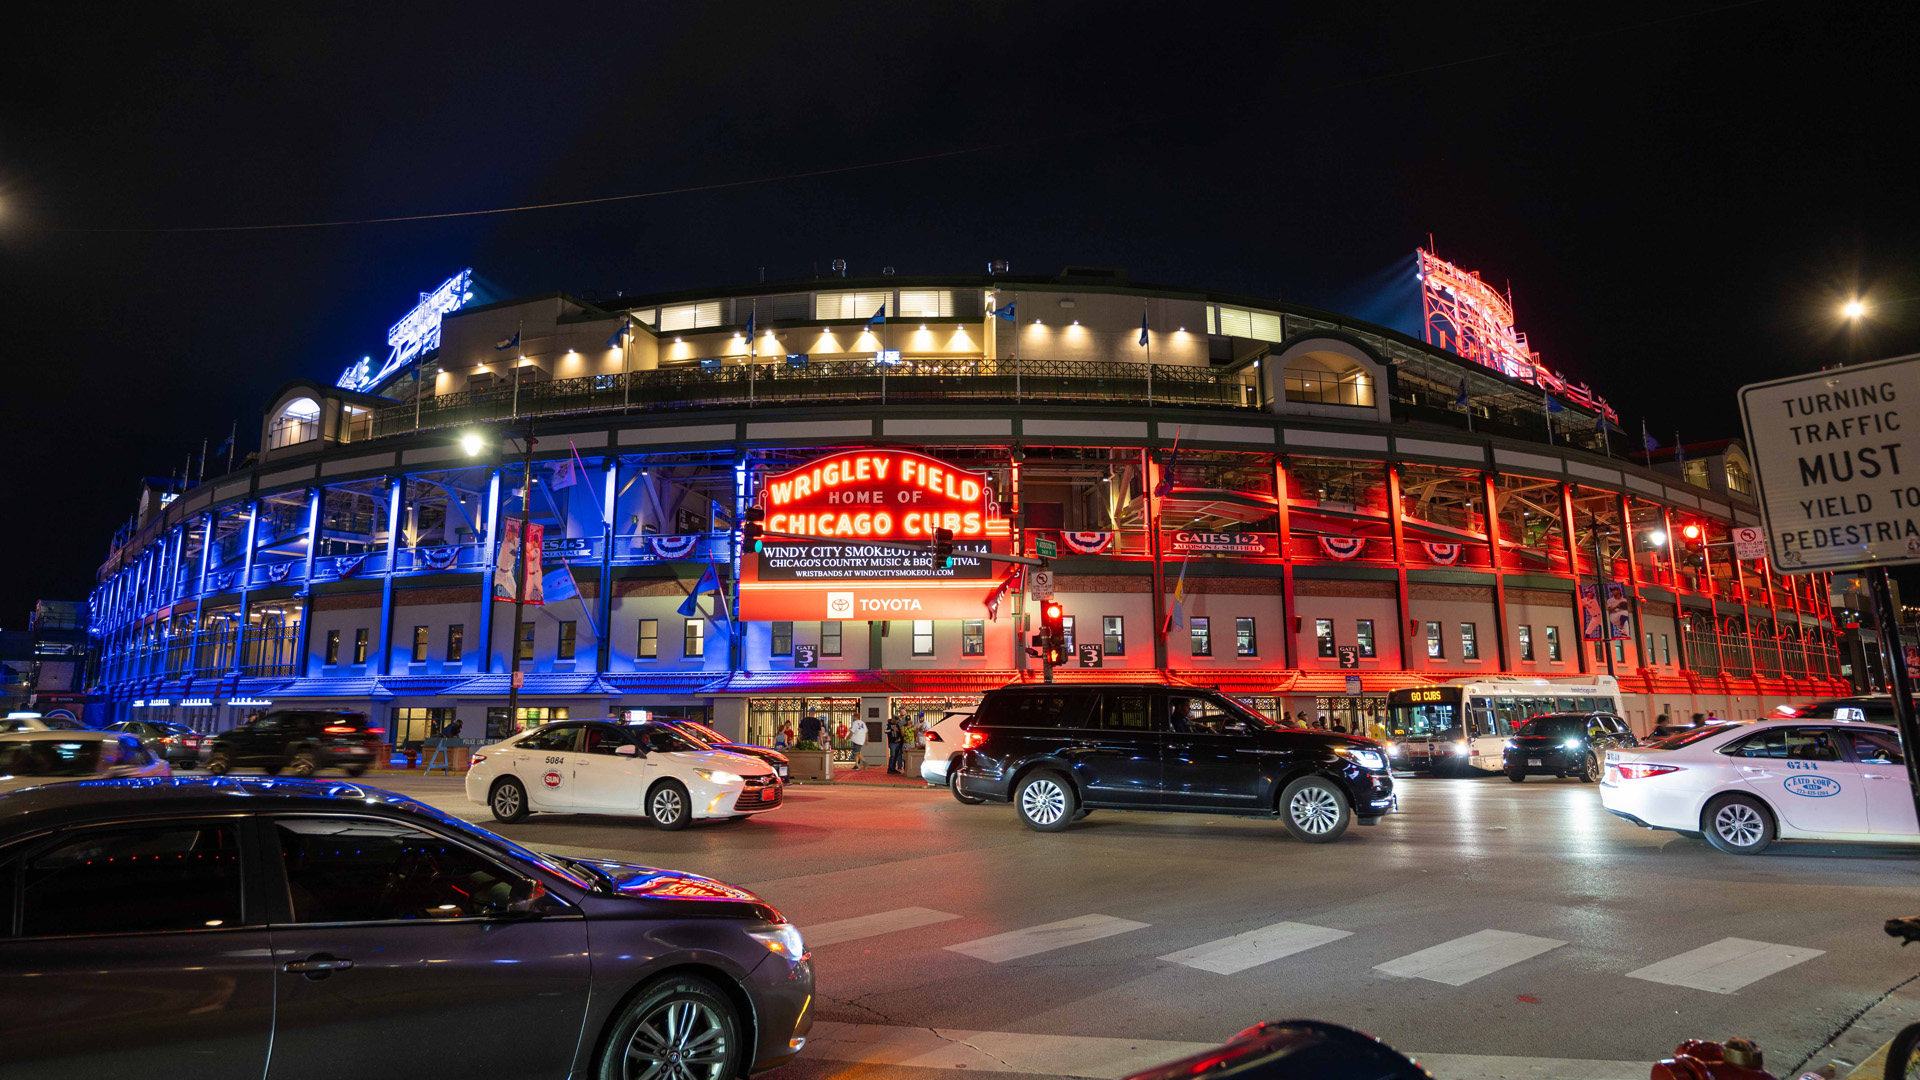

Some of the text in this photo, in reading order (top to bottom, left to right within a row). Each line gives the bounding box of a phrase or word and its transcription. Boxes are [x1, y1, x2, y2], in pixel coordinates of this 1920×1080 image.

[1782, 382, 1896, 418] TURNING
[1789, 411, 1901, 446] TRAFFIC
[1798, 443, 1902, 487] MUST
[770, 457, 980, 505] WRIGLEY FIELD
[829, 490, 923, 504] HOME OF
[1799, 486, 1920, 520] YIELD TO
[769, 512, 981, 536] CHICAGO CUBS
[1175, 532, 1230, 543] GATES
[763, 546, 809, 558] WINDY
[811, 546, 842, 557] CITY
[769, 558, 821, 568] CHICAGO'S
[822, 558, 869, 567] COUNTRY
[870, 558, 901, 567] MUSIC
[903, 558, 911, 566] &
[913, 557, 933, 568] BBQ
[795, 570, 842, 578] WRISTBANDS
[859, 598, 922, 611] TOYOTA
[799, 650, 813, 663] 3
[1083, 649, 1098, 663] 3
[1342, 651, 1355, 664] 3
[1411, 691, 1441, 701] GO CUBS
[545, 756, 564, 765] 5084
[1787, 761, 1819, 770] 6744
[545, 775, 560, 784] SUN
[1812, 778, 1831, 788] CORP
